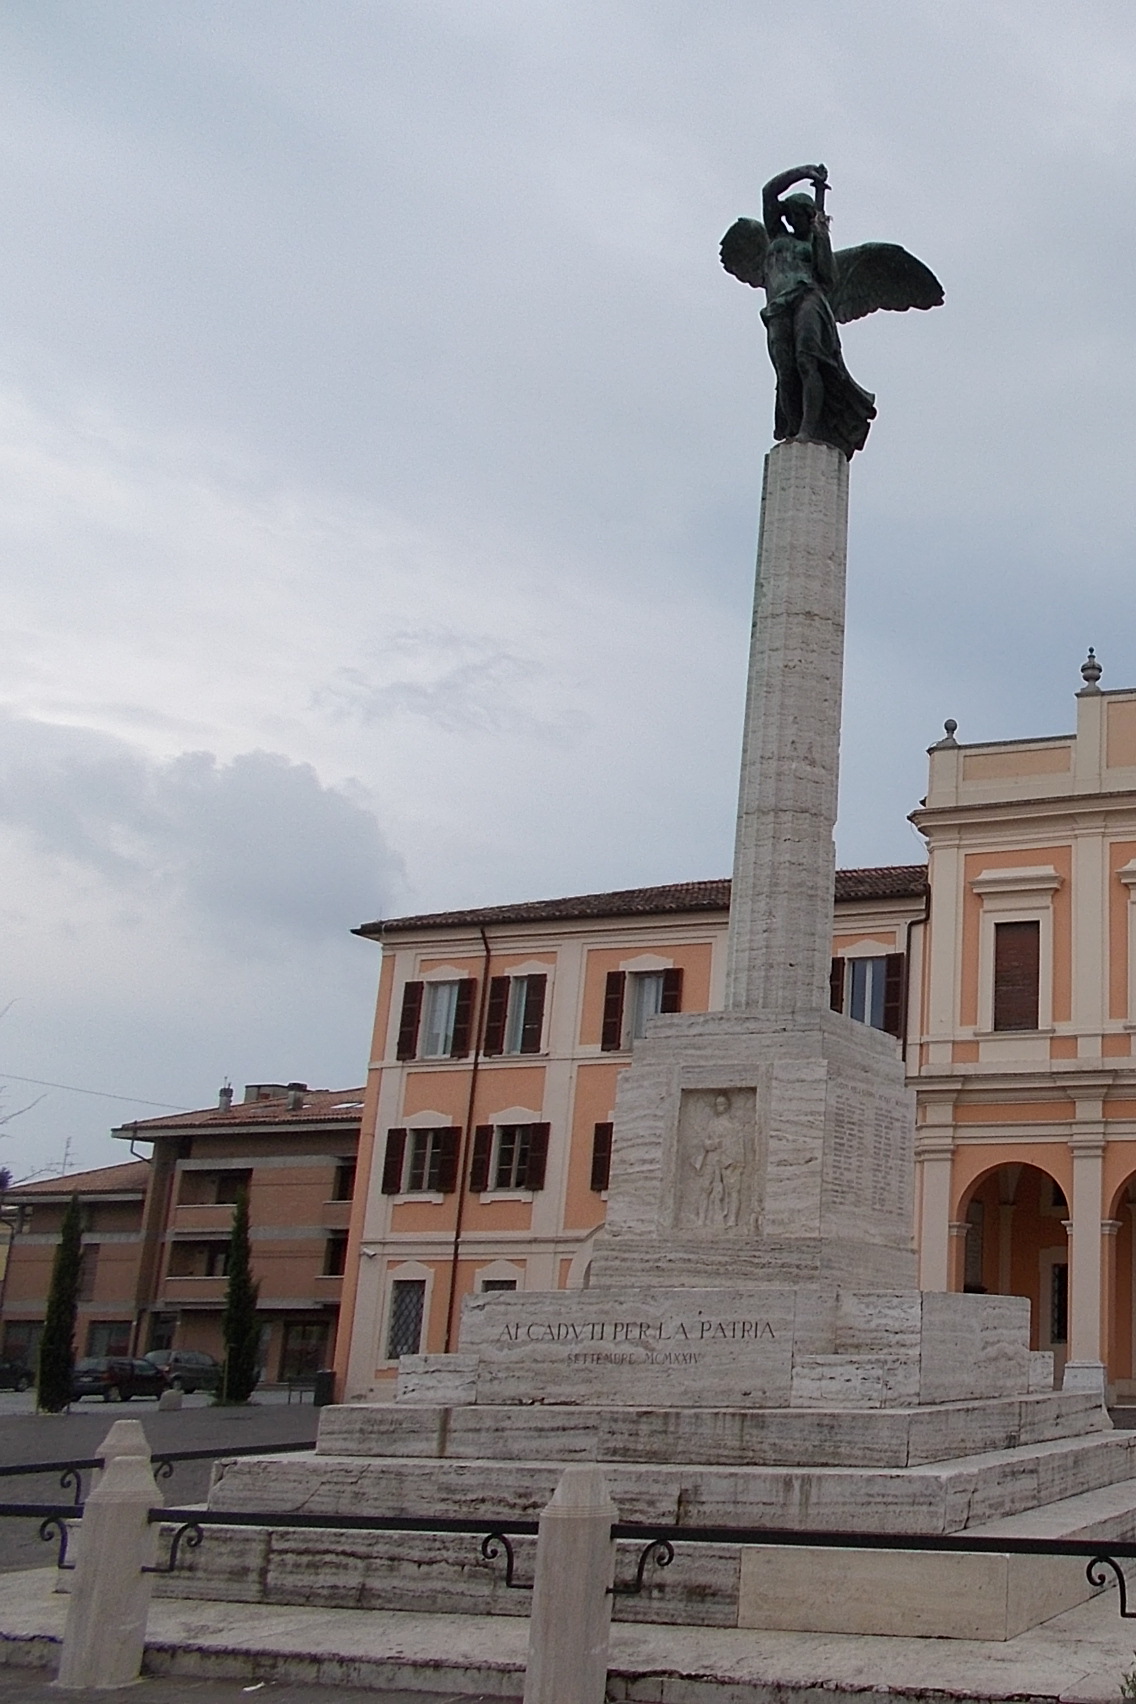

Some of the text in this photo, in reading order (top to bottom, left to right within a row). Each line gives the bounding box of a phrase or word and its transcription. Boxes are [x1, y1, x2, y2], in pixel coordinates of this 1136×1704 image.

[500, 1320, 775, 1341] AI CADVTI PER LA PATRIA
